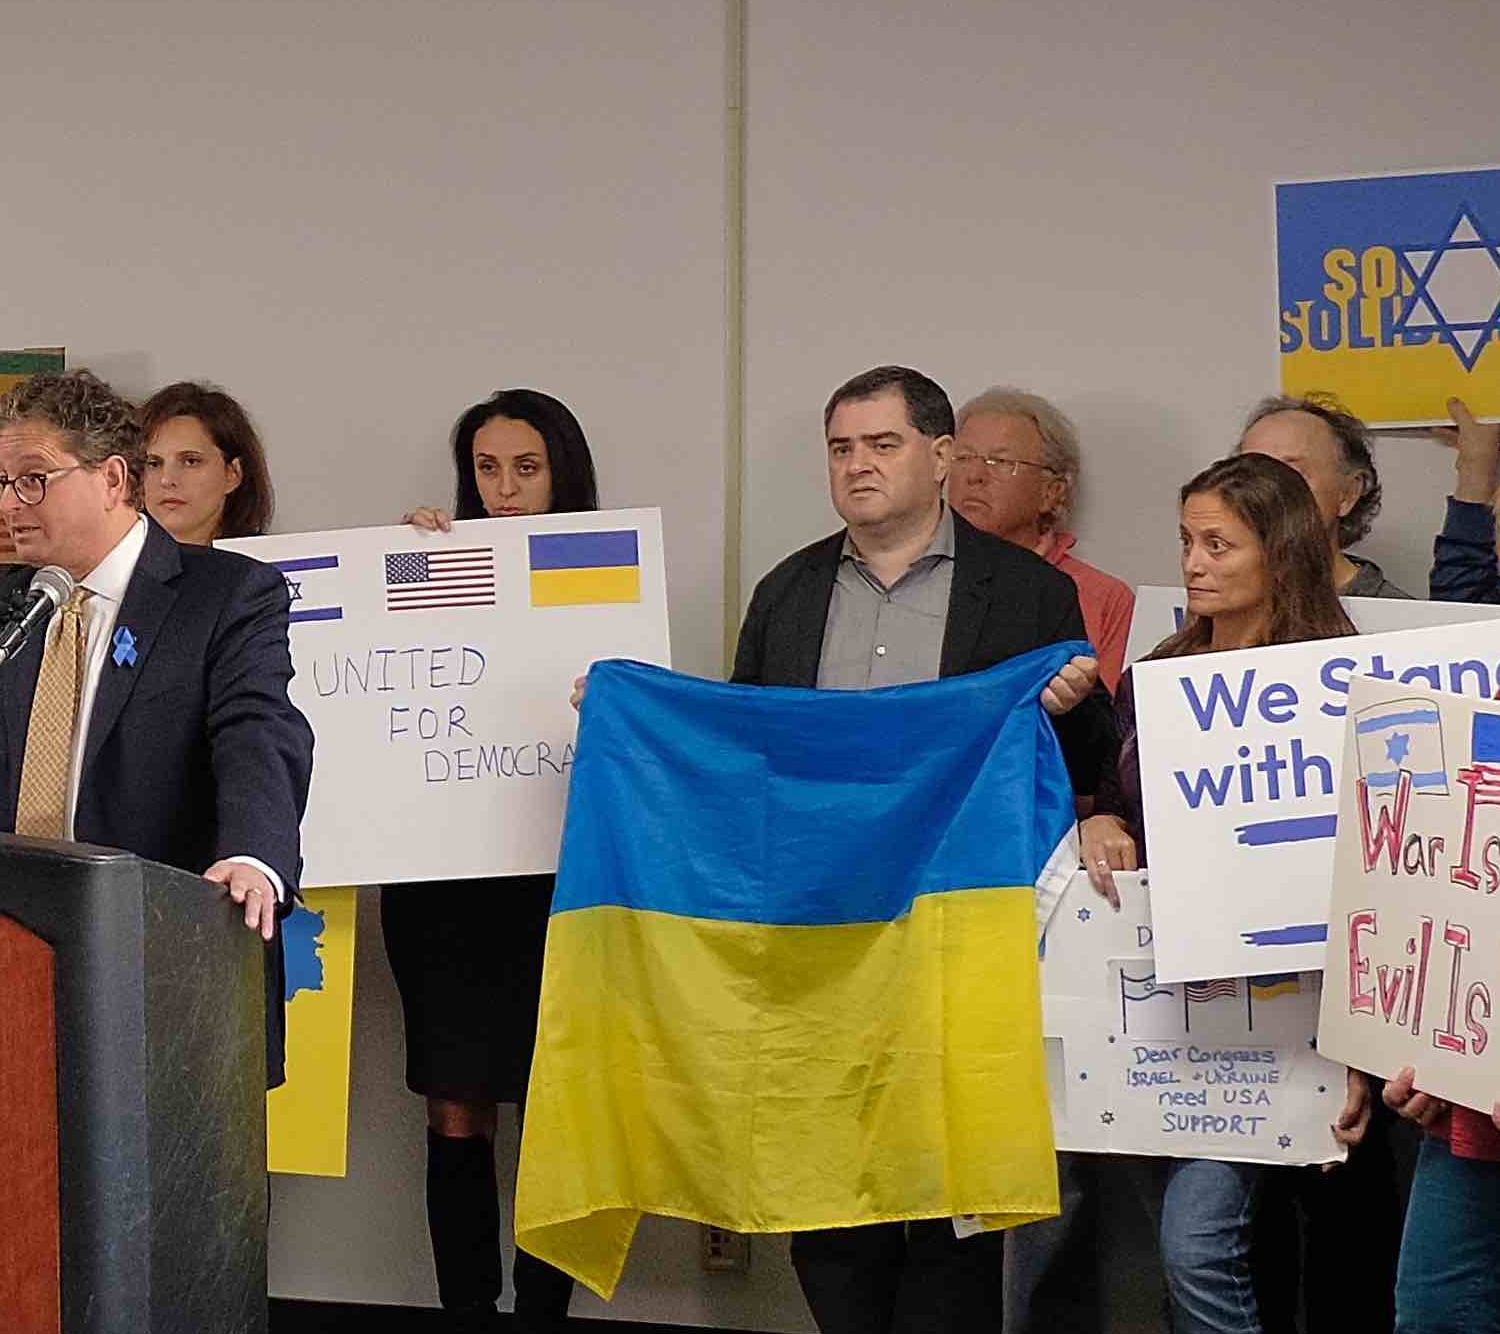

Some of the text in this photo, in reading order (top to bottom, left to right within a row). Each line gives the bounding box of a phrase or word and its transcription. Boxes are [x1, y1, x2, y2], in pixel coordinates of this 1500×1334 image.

[312, 647, 485, 697] UNITED
[1179, 669, 1298, 732] We
[388, 706, 473, 742] FOR
[424, 741, 576, 784] DEMOCRA
[1174, 738, 1334, 809] with
[1355, 767, 1445, 876] War
[1349, 909, 1434, 1036] Evil
[1432, 920, 1492, 1055] Is
[1133, 1046, 1182, 1065] Dear
[1205, 1068, 1280, 1085] UKRAINE
[1159, 1089, 1272, 1107] need USA
[1162, 1112, 1268, 1137] SUPPORT
